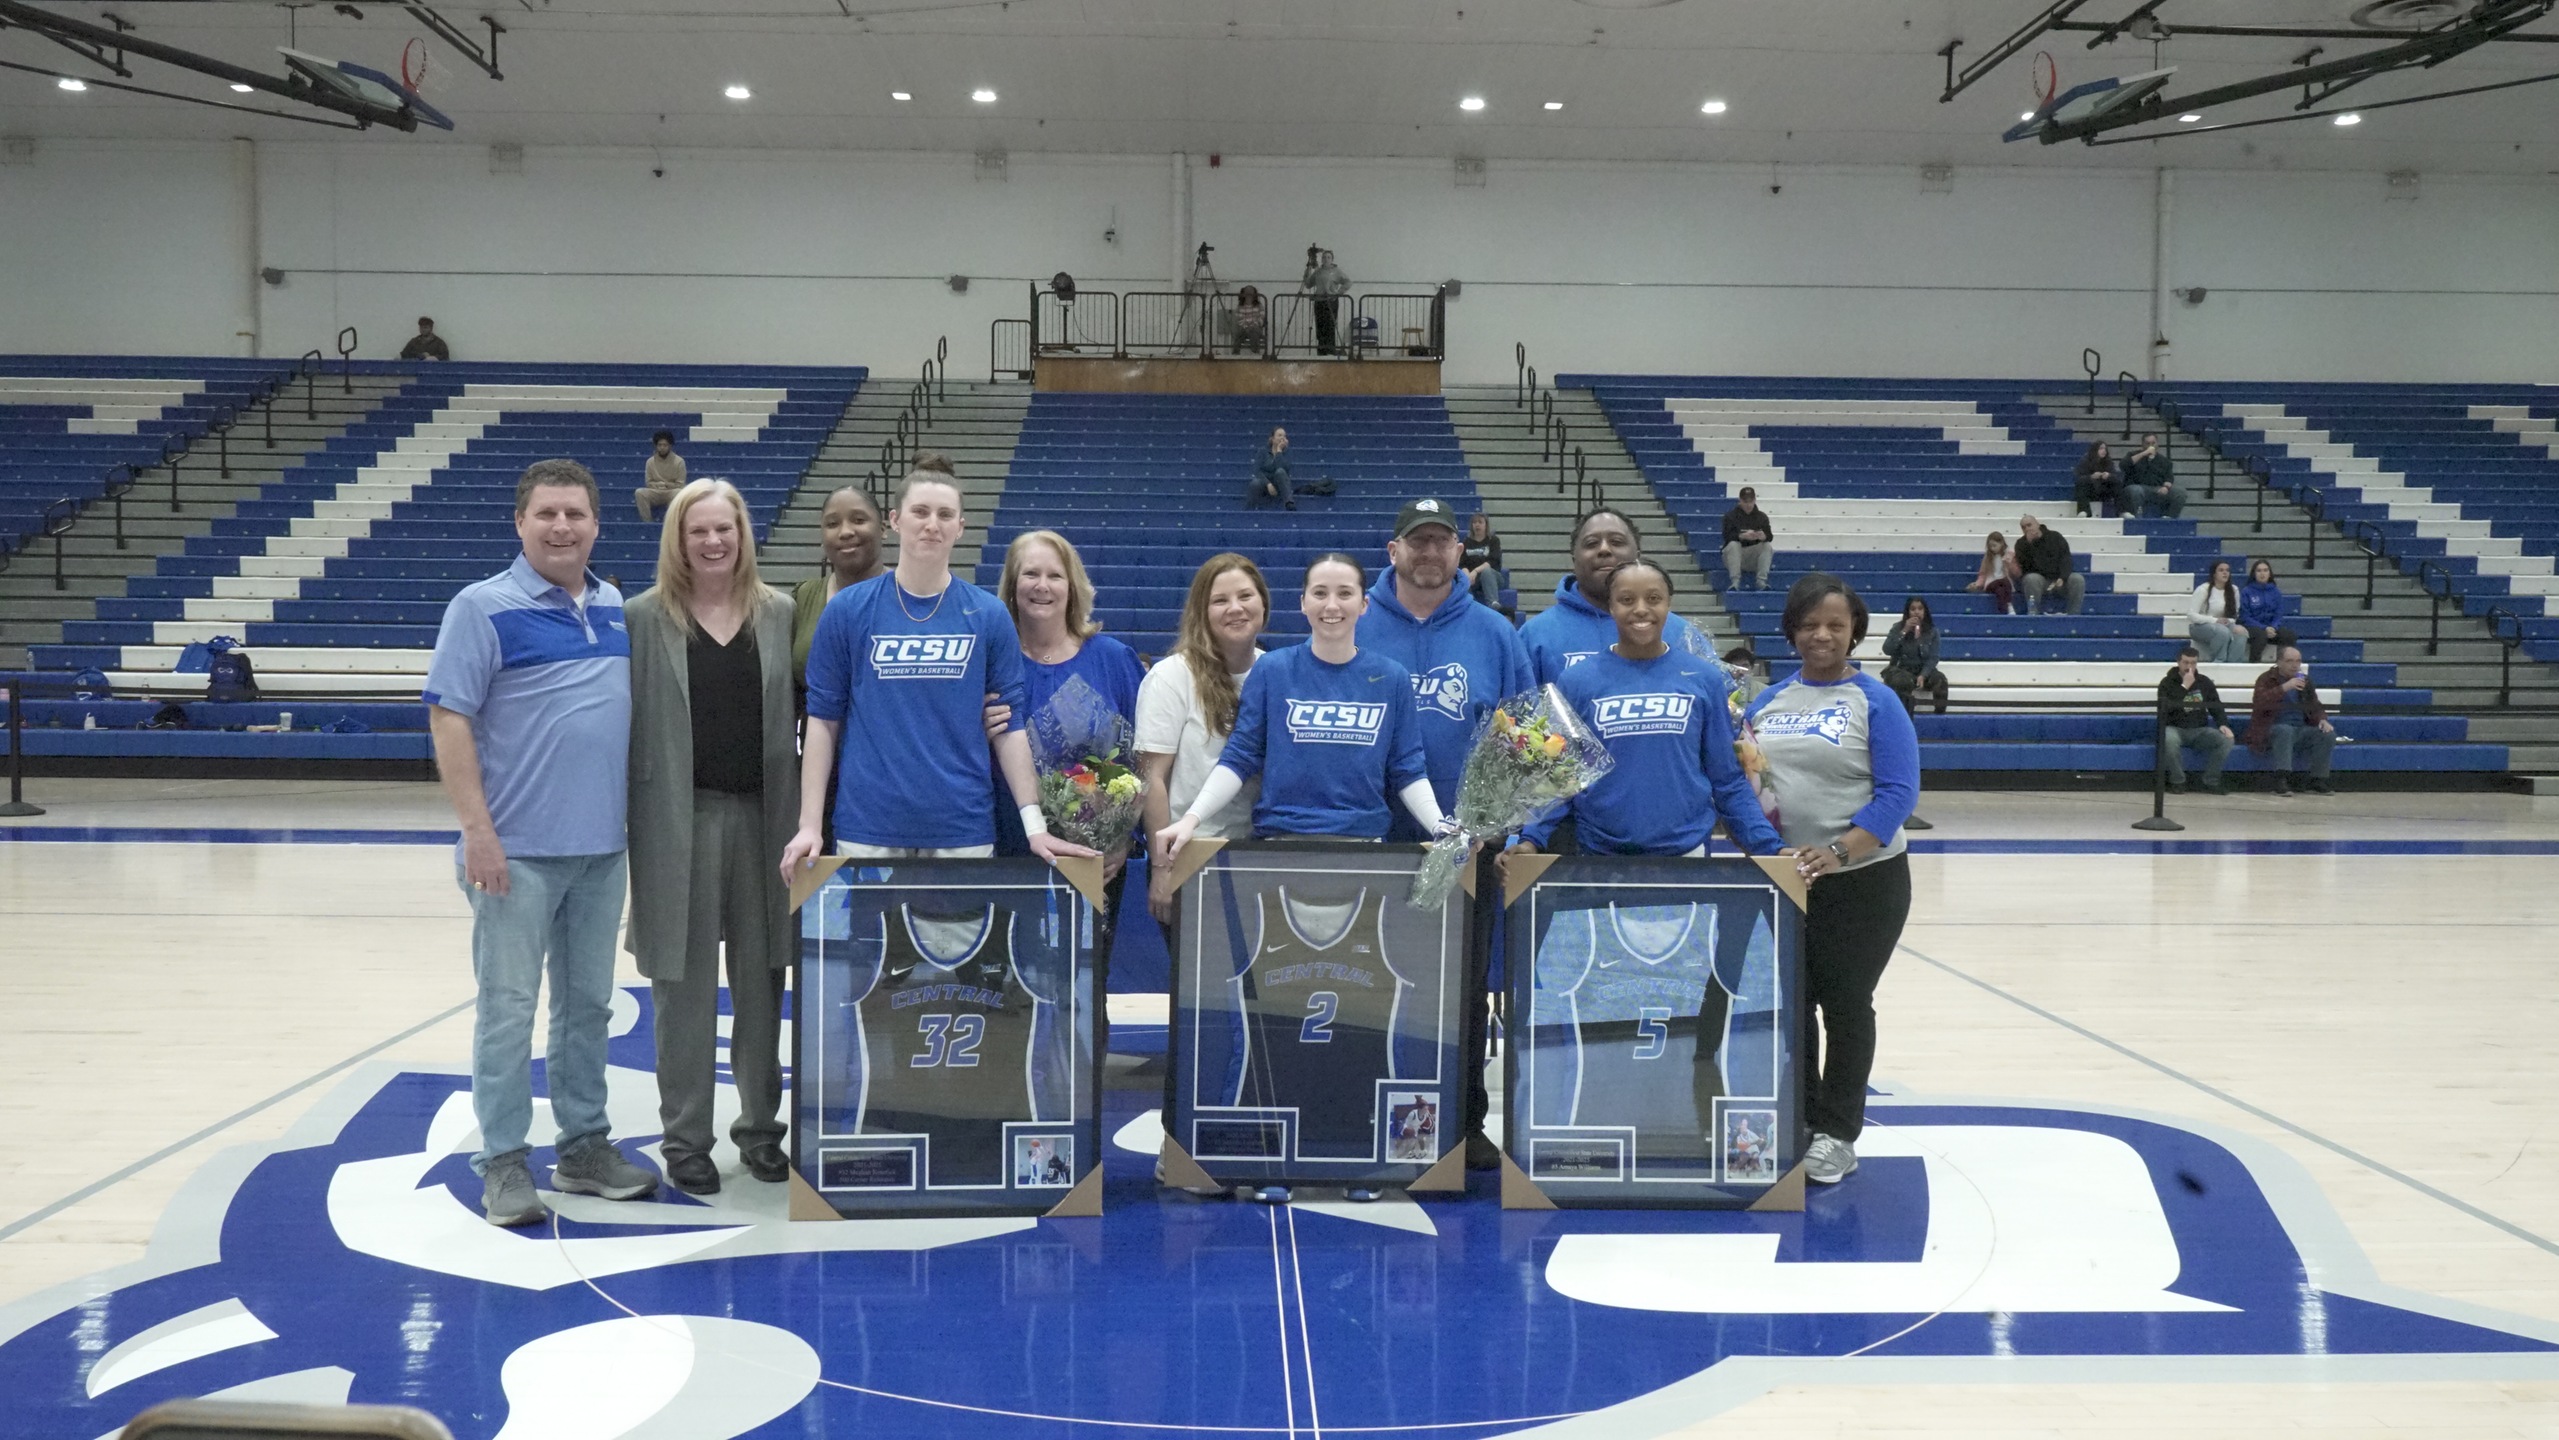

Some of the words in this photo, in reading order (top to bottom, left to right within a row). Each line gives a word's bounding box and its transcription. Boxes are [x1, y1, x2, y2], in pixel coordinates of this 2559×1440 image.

[875, 639, 971, 662] CCSU
[882, 667, 916, 675] WOMEN'S
[917, 667, 961, 675] BASKETBALL
[1290, 705, 1376, 729] CCSU
[1599, 696, 1689, 722] CCSU
[1766, 714, 1826, 725] CENTRAL
[1297, 731, 1331, 739] WOMEN'S
[1332, 732, 1373, 741] BASKETBALL
[1606, 724, 1640, 734] WOMEN'S
[1641, 722, 1683, 731] BASKETBALL
[1265, 962, 1374, 988] CENTRAL
[891, 984, 1004, 1010] CENTRAL
[1299, 991, 1339, 1043] 2
[910, 1014, 986, 1068] 32
[1632, 1007, 1672, 1060] 5
